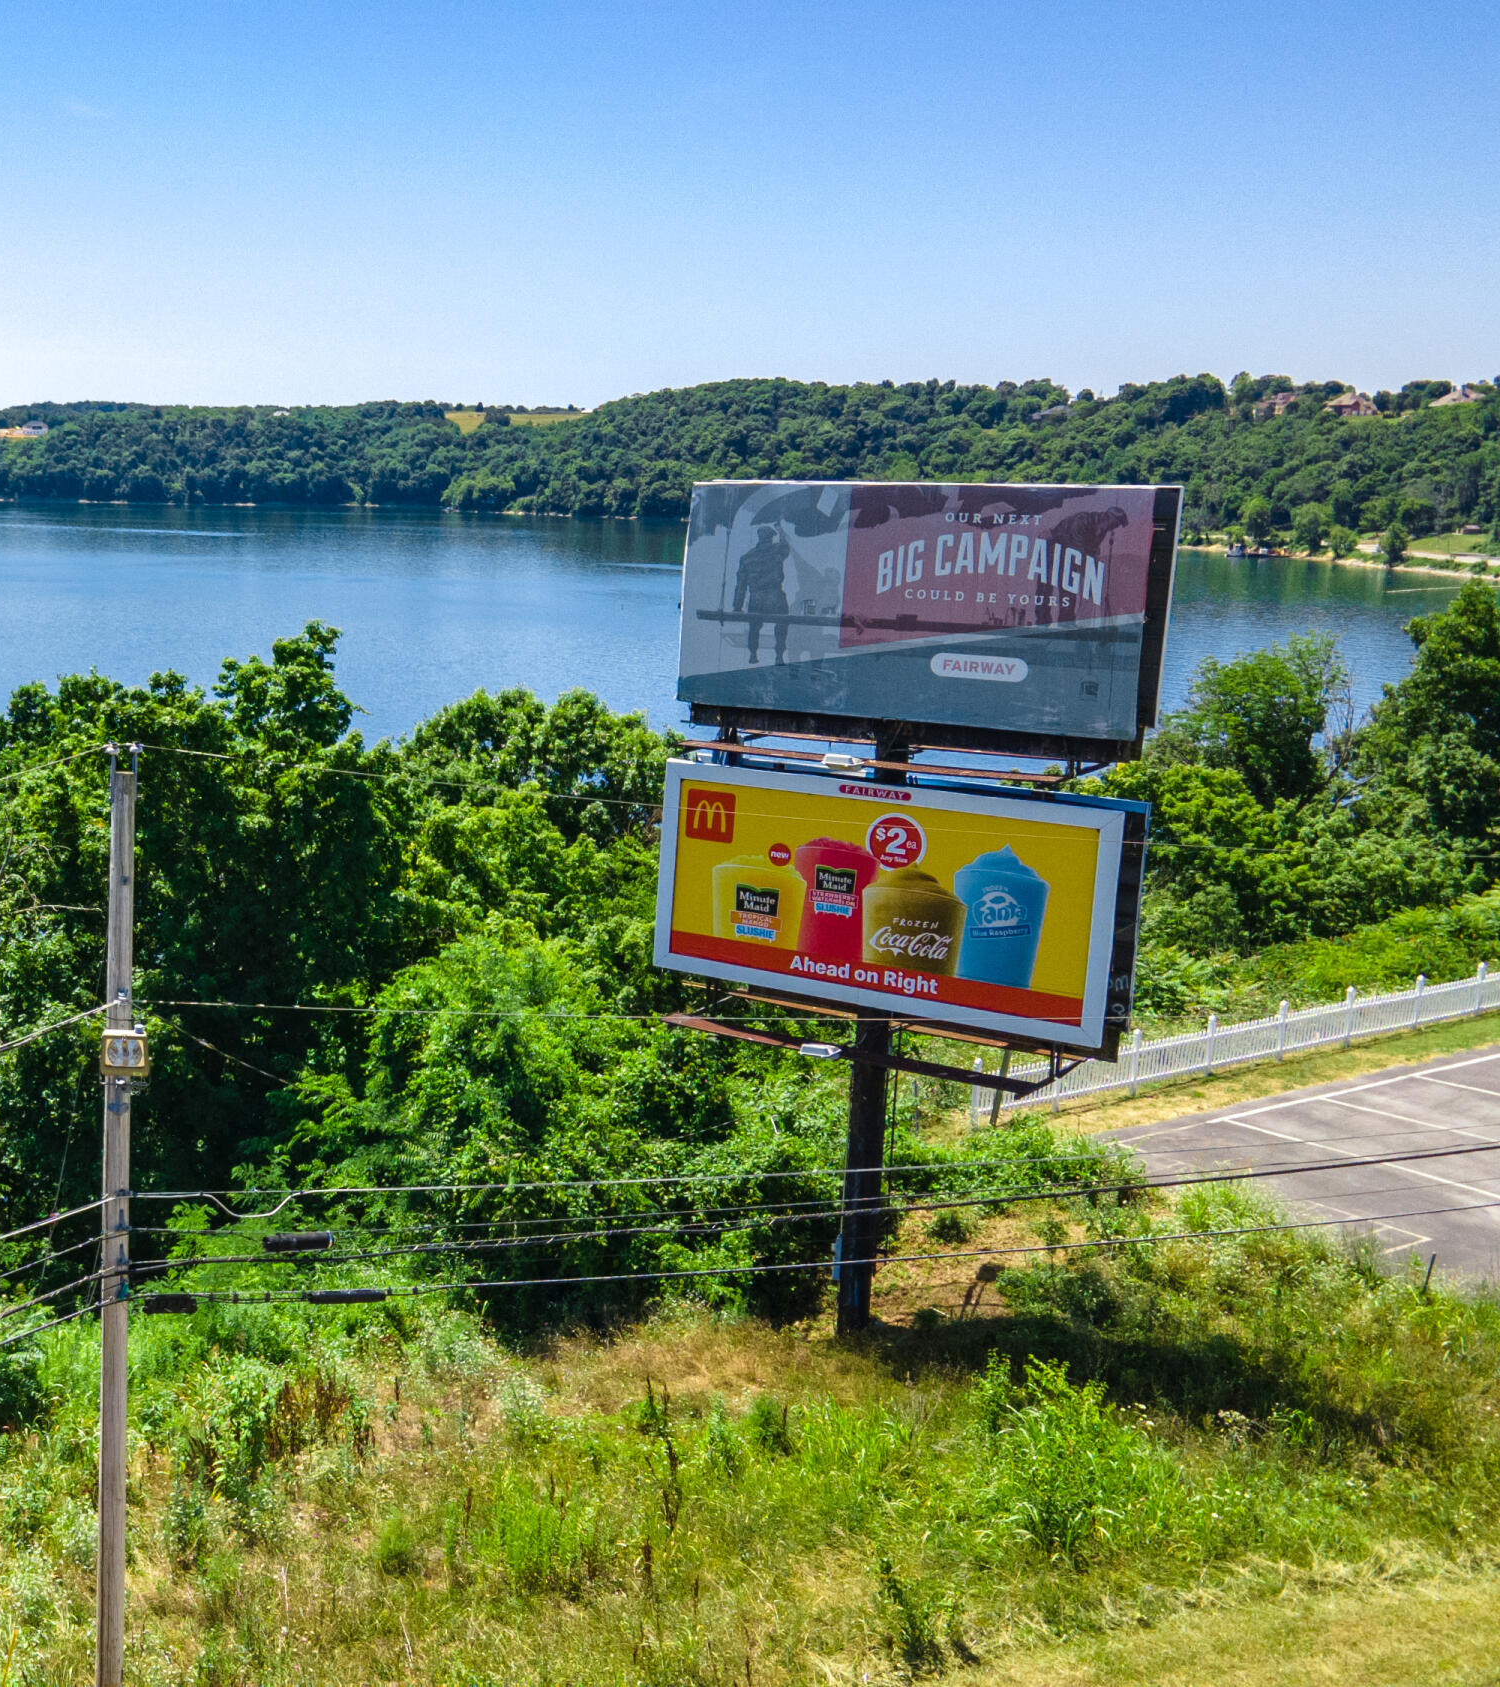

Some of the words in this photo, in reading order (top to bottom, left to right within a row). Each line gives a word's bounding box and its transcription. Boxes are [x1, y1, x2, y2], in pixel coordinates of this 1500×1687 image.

[945, 512, 982, 524] OUR
[993, 513, 1042, 525] NEXT
[876, 539, 925, 595] BIG
[935, 532, 1105, 606] CAMPAIGN
[905, 589, 965, 602] COULD
[976, 592, 997, 603] BE
[1007, 593, 1070, 607] YOURS
[943, 659, 1016, 675] FAIRWAY
[845, 785, 905, 800] FAIRWAY
[875, 826, 907, 855] $2
[771, 851, 789, 860] new
[880, 854, 893, 863] Any
[819, 872, 853, 885] Minute
[822, 880, 847, 891] Maid
[739, 890, 776, 905] Minute
[743, 900, 770, 912] Maid
[815, 902, 850, 915] SLUSHIE
[972, 899, 1027, 926] Fanta
[739, 912, 772, 923] TROPICAL
[742, 919, 769, 928] MANGO
[893, 917, 939, 929] FROZEN
[736, 925, 774, 939] SLUSHIE
[989, 928, 1028, 937] Raspberry
[790, 955, 850, 979] Ahead
[854, 969, 879, 984] on
[884, 970, 938, 994] Right
